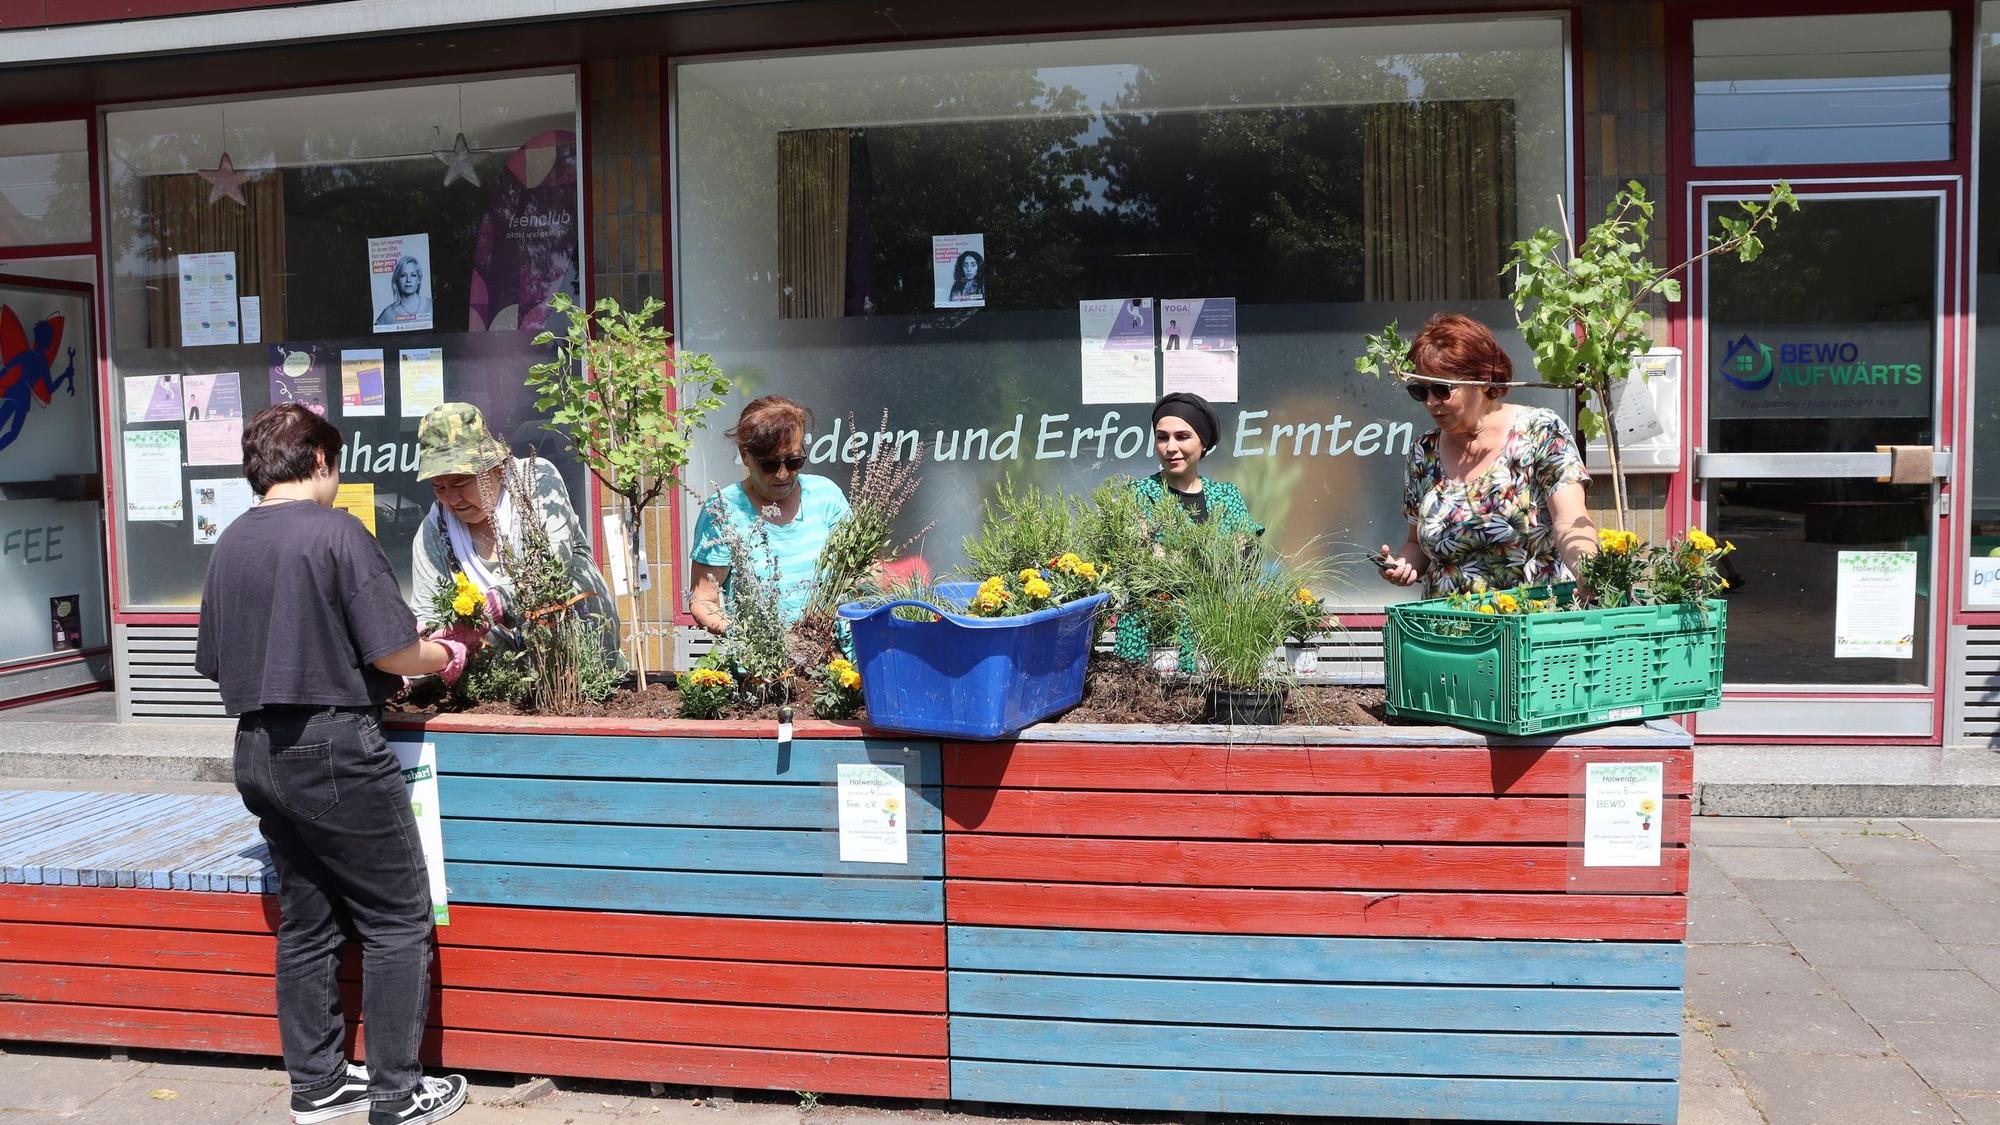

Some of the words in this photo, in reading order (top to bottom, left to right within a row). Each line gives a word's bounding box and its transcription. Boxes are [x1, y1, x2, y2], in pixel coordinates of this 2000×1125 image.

[1083, 304, 1108, 313] TANZ
[1164, 304, 1188, 312] YOGA
[1780, 343, 1858, 363] BEWO
[1778, 362, 1922, 386] AUFWÄRTS
[933, 413, 1024, 463] und
[1233, 409, 1414, 458] Ernten
[4, 525, 64, 564] FEE
[402, 766, 431, 781] ssbar!
[1602, 775, 1637, 784] Holweide
[849, 777, 882, 787] Holweide
[1596, 799, 1626, 809] BEWO
